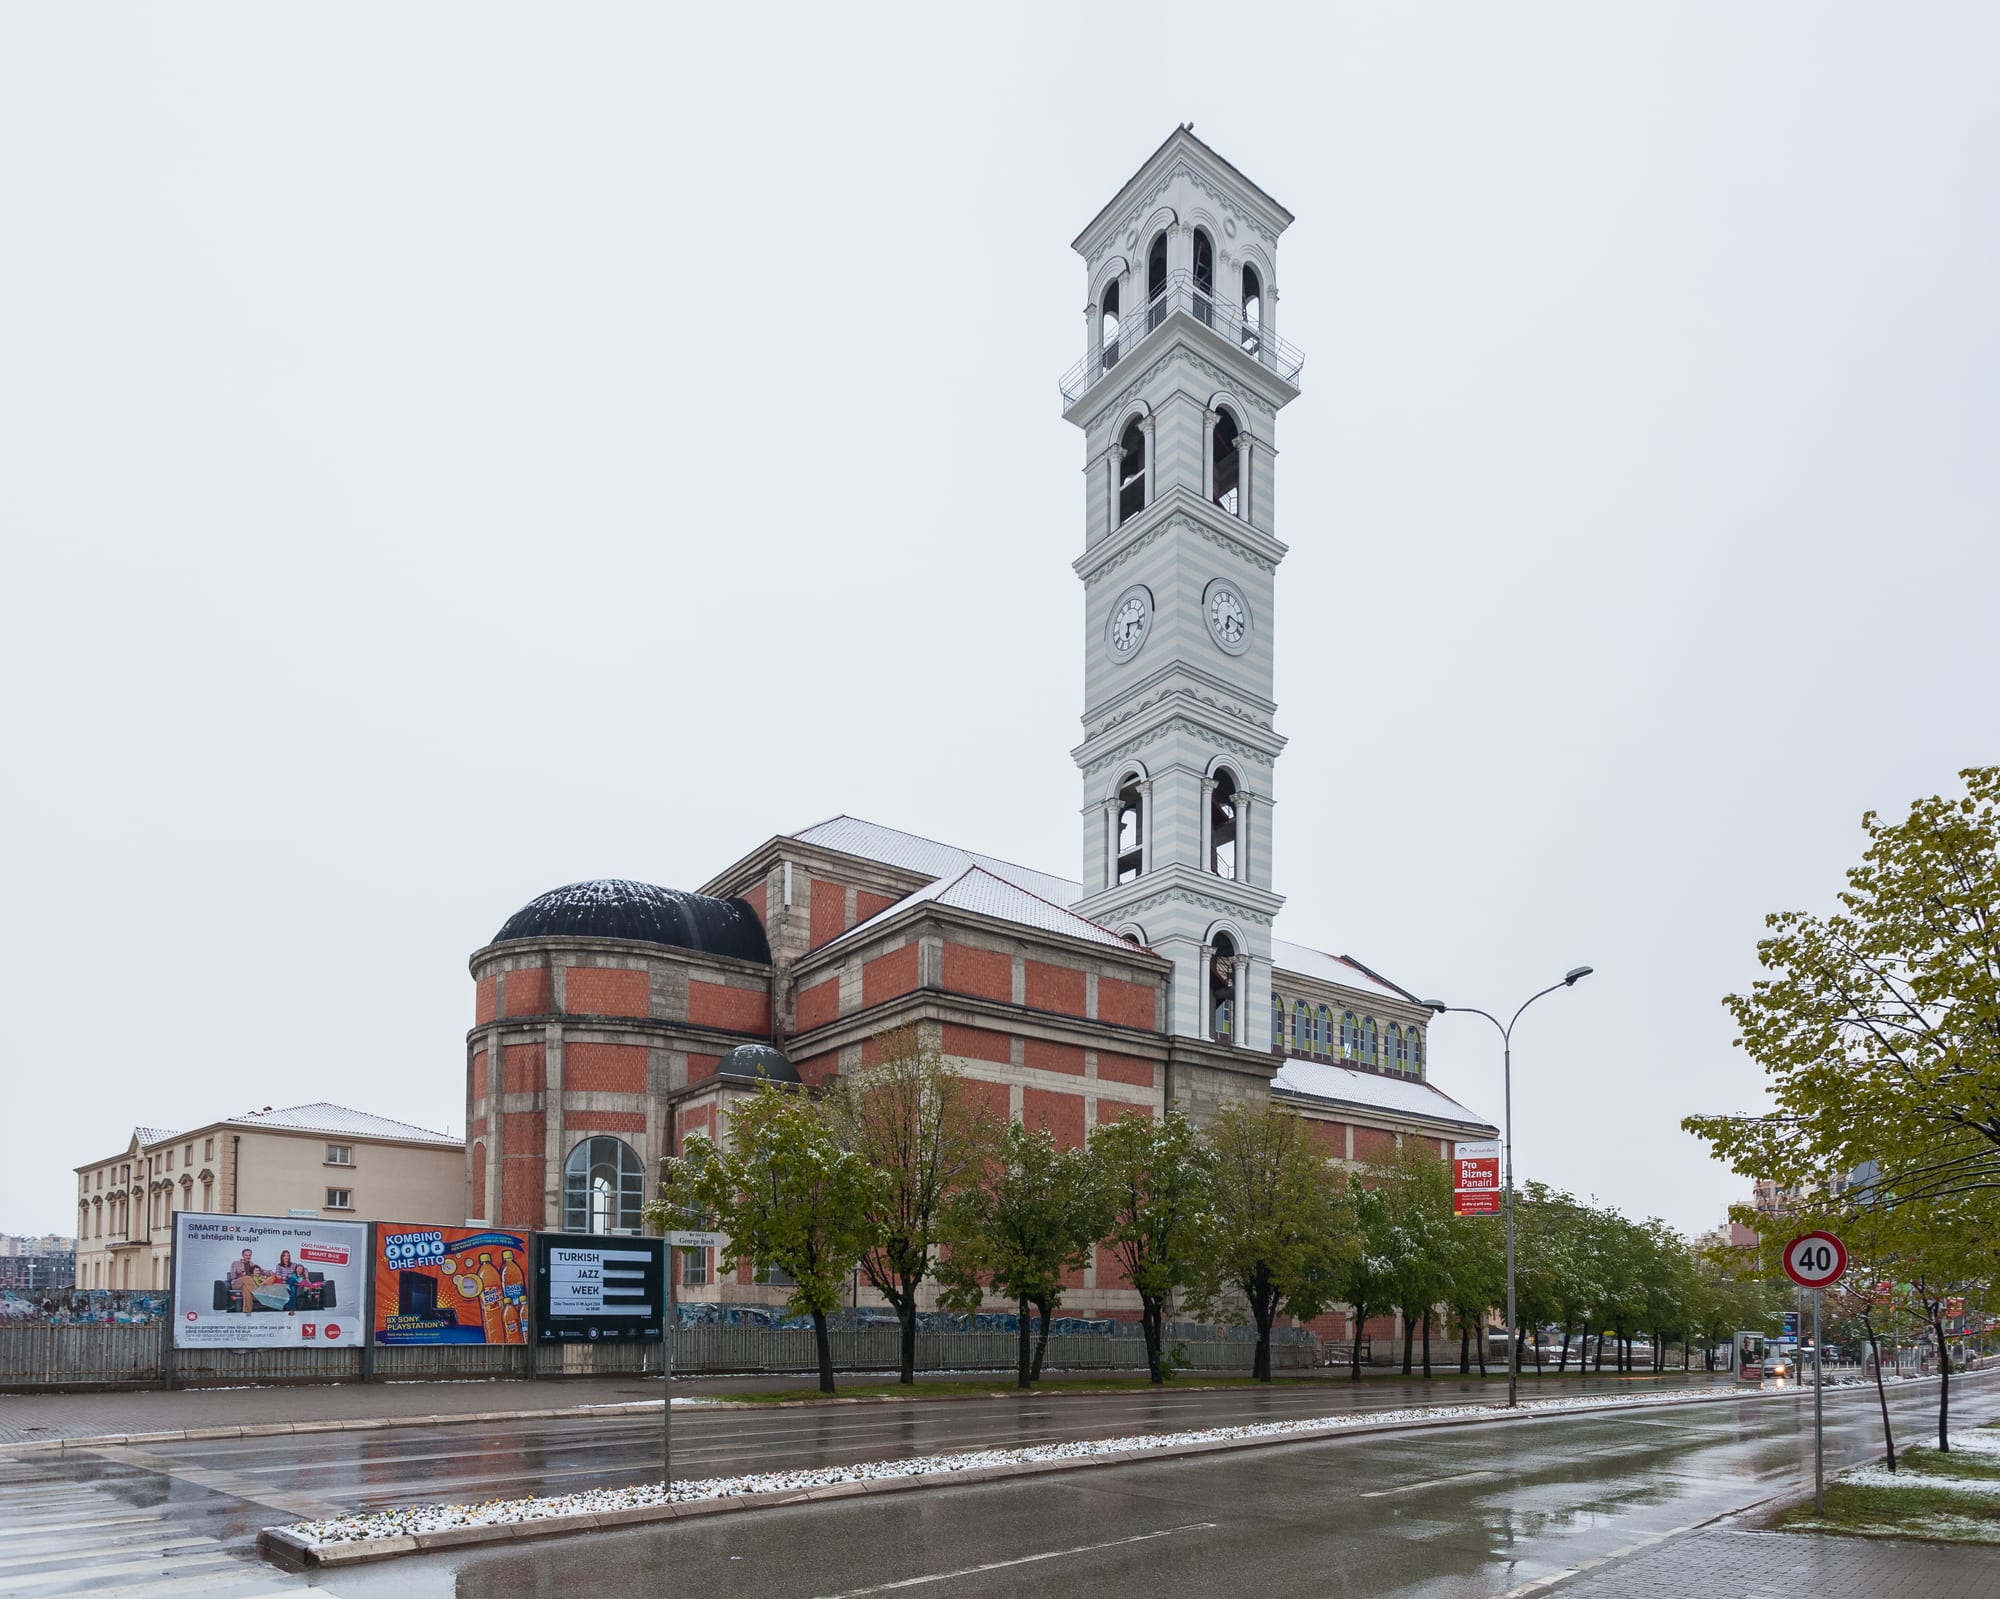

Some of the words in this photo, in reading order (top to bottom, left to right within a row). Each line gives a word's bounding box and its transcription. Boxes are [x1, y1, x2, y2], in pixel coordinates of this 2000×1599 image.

[1462, 1161, 1477, 1169] Pro
[1462, 1169, 1493, 1178] Biznes
[1461, 1178, 1492, 1187] Panairi
[188, 1223, 219, 1232] SMART
[222, 1225, 241, 1233] BOX
[248, 1226, 281, 1236] Argëtim
[282, 1229, 292, 1237] pa
[294, 1228, 311, 1237] fund
[236, 1234, 259, 1243] tuaja!
[385, 1231, 442, 1245] KOMBINO
[679, 1237, 699, 1245] George
[558, 1252, 599, 1262] TURKISH
[1799, 1246, 1831, 1271] 40
[389, 1258, 415, 1270] DHE
[417, 1255, 445, 1267] FITO
[578, 1269, 600, 1279] JAZZ
[571, 1286, 599, 1295] WEEK
[484, 1294, 499, 1303] Sola
[397, 1315, 419, 1323] SONY
[387, 1321, 438, 1331] PLAYSTATION
